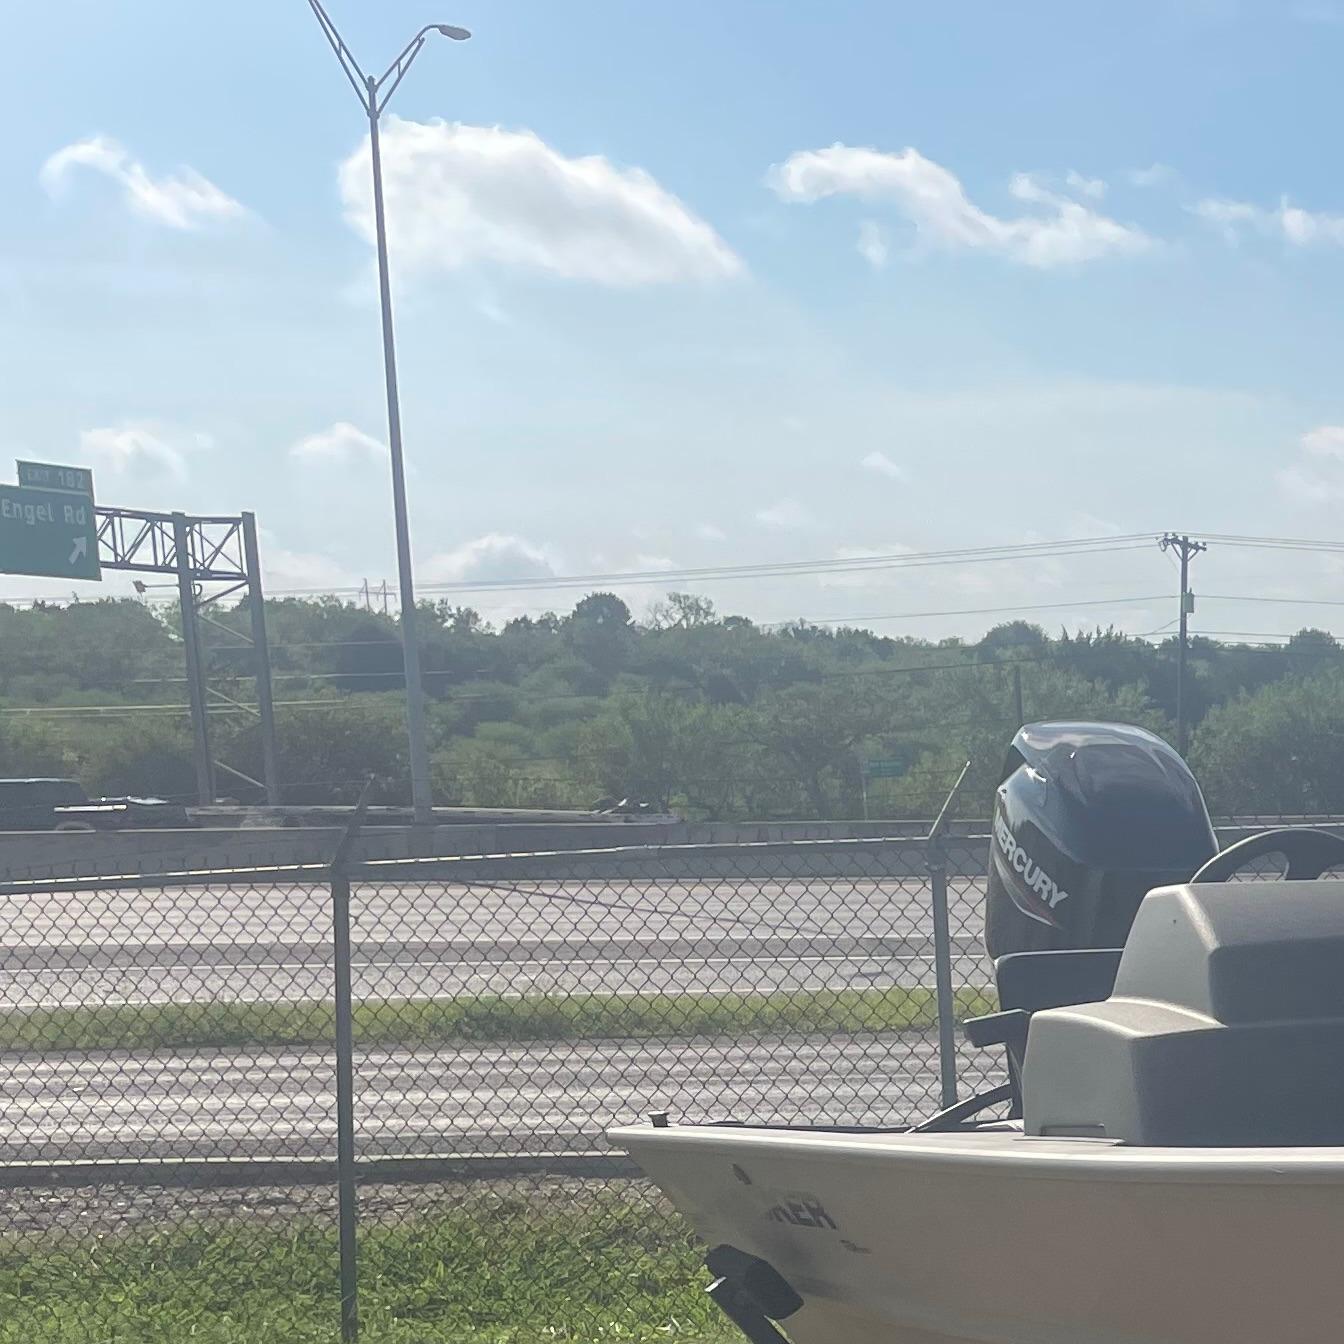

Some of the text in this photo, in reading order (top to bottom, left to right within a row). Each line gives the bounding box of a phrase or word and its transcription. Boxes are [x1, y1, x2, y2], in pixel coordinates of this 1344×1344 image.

[57, 470, 85, 490] 182
[1, 498, 87, 526] Engel Rd
[994, 806, 1069, 909] MERCURY
